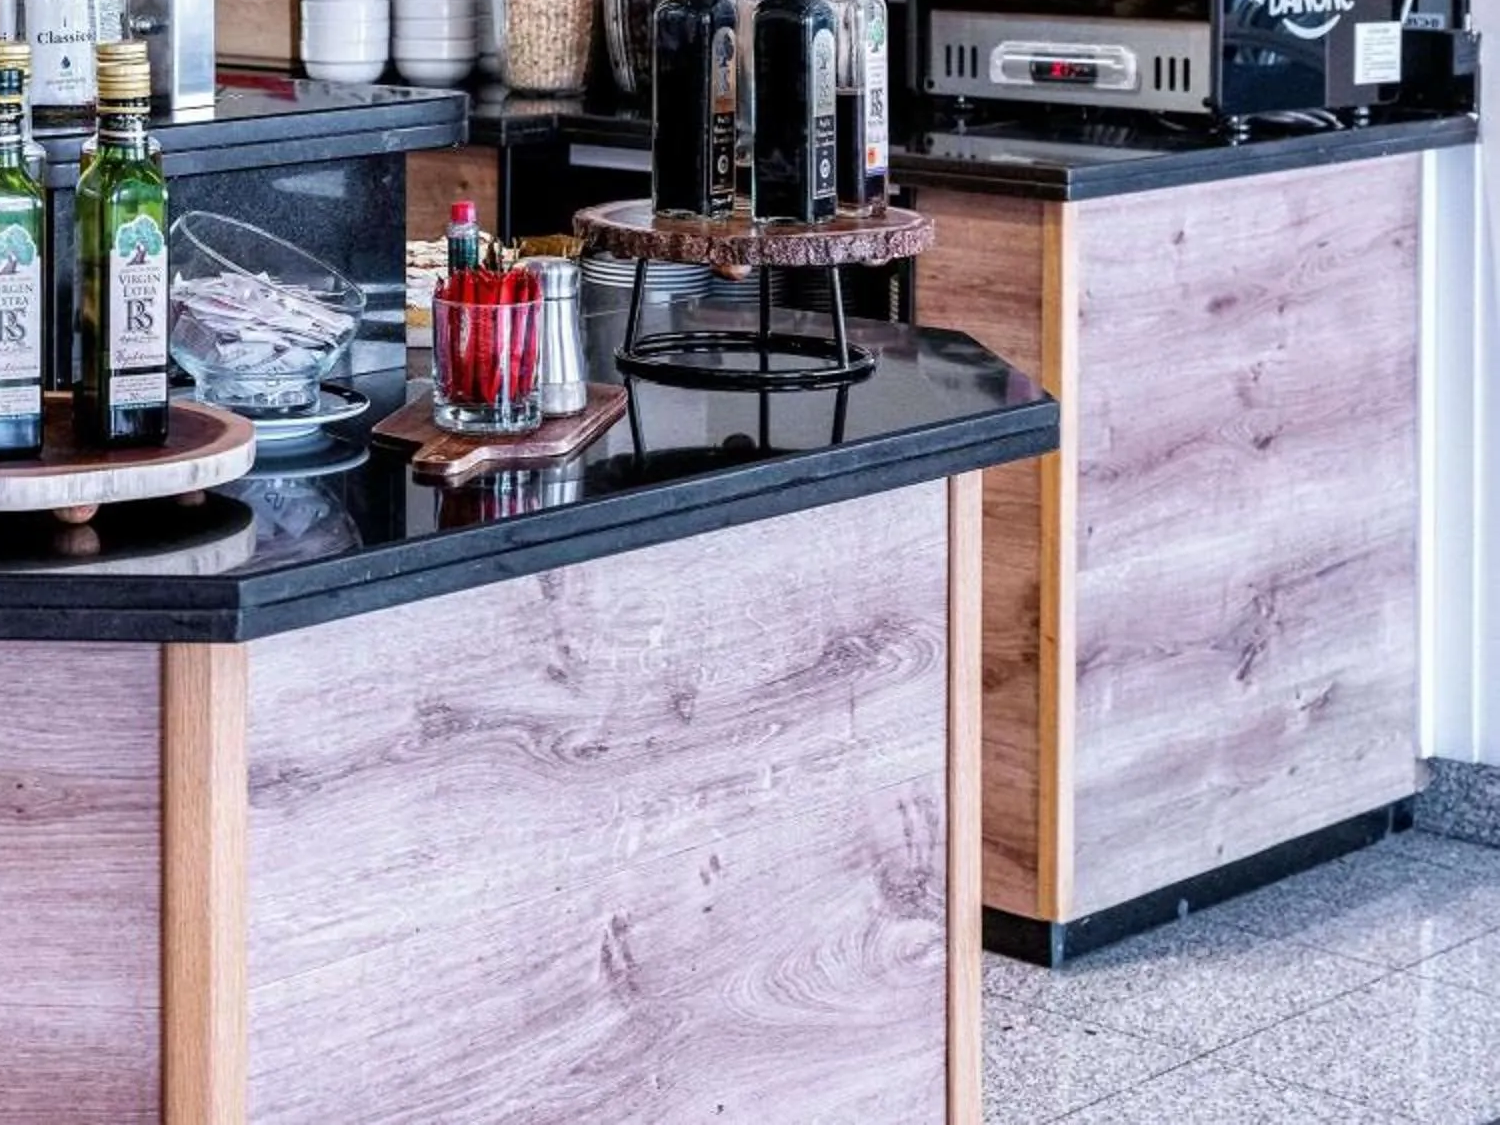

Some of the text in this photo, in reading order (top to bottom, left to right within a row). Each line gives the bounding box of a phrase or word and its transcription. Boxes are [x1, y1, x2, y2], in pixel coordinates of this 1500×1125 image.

[118, 274, 161, 285] VIRGEN
[123, 285, 157, 298] EXTRA
[125, 297, 155, 334] RS
